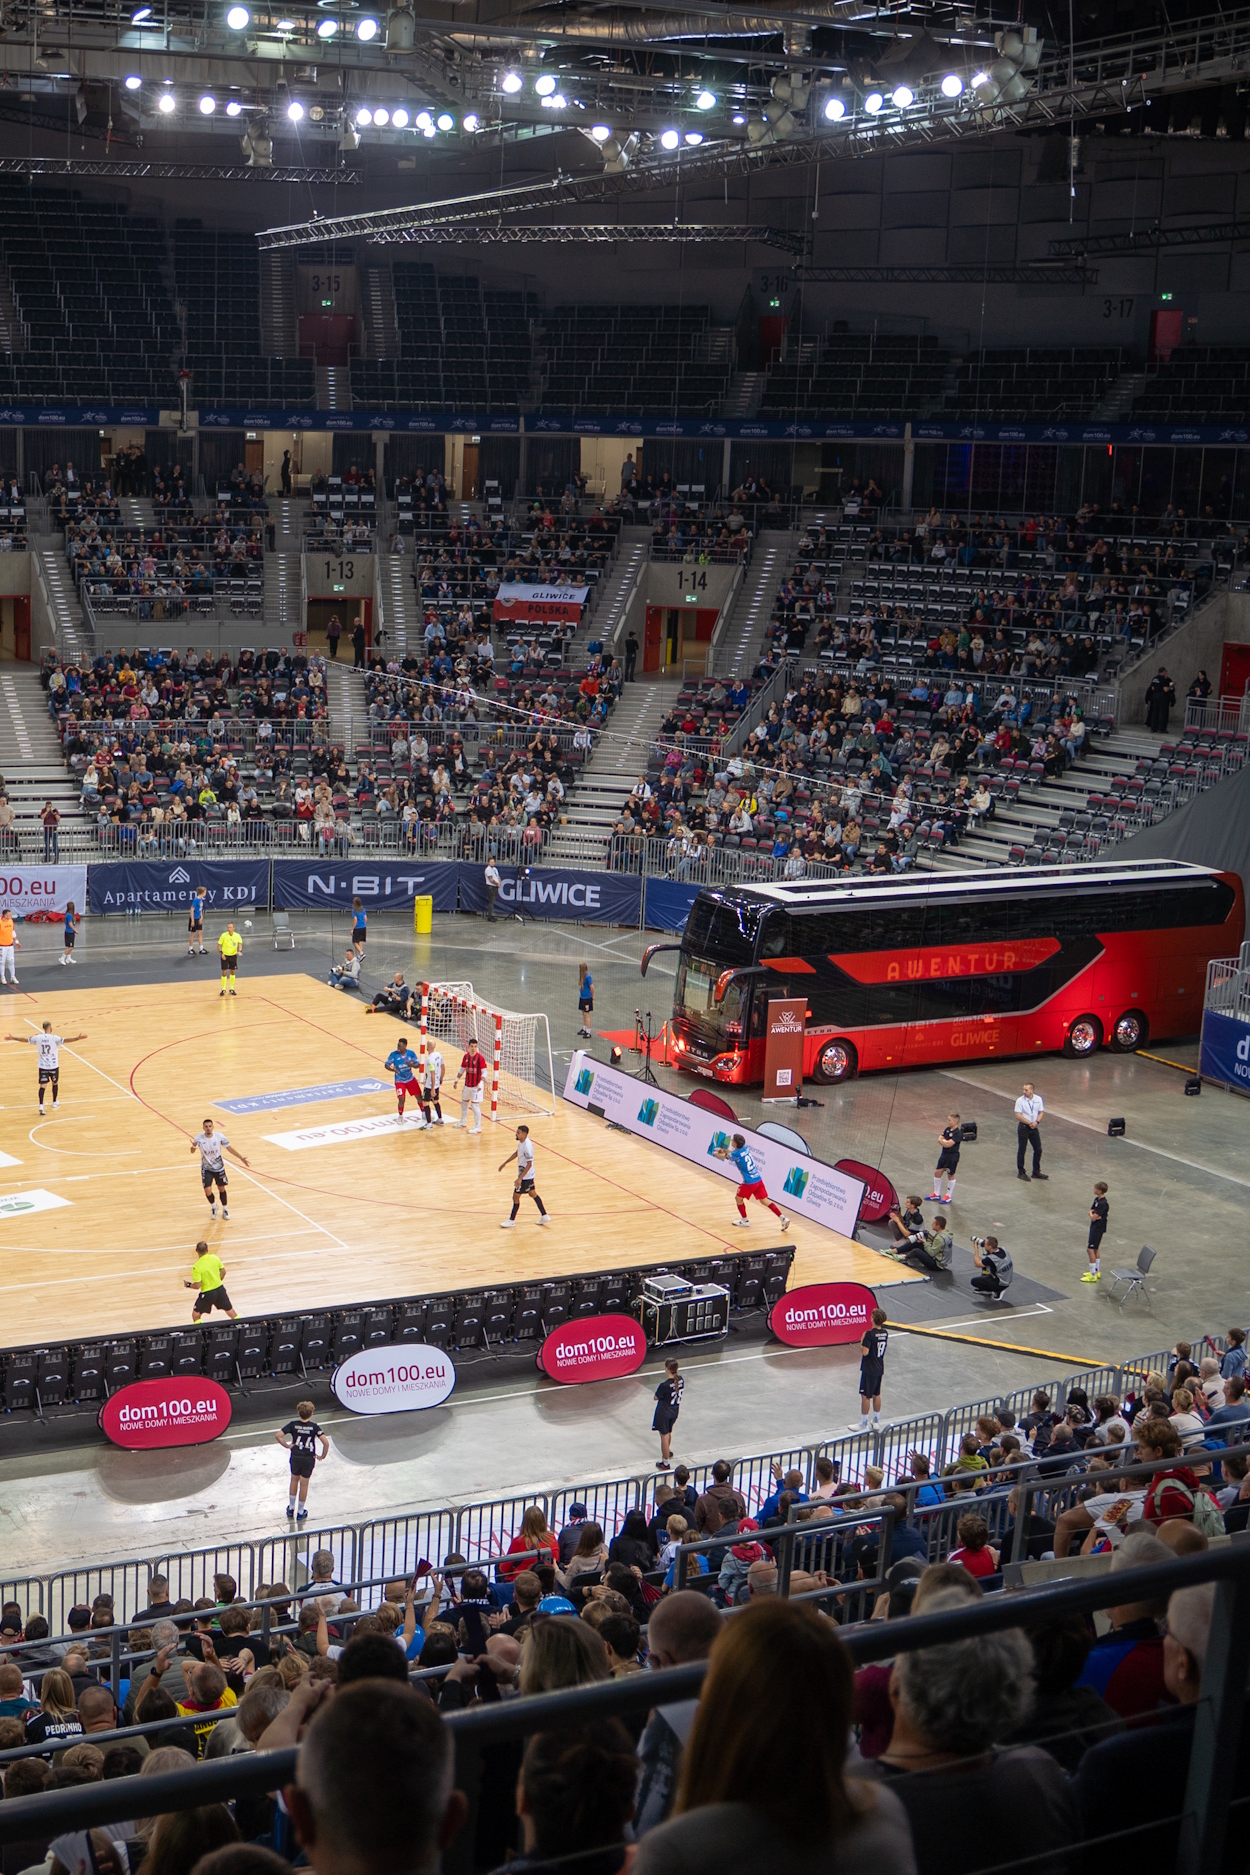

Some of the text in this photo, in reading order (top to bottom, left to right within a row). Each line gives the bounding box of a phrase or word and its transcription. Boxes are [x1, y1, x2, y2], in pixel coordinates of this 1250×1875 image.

[312, 275, 340, 292] 3-15
[324, 561, 353, 579] 1-13
[677, 570, 707, 590] 1-14
[532, 592, 576, 600] GLIWICE
[528, 604, 569, 615] POLSKA
[103, 885, 257, 906] Apartameny KDJ
[497, 878, 601, 907] GLIWICE
[0, 897, 56, 908] MIESZKANIA
[887, 952, 1015, 980] AWENTUR
[770, 1026, 802, 1034] AWENTUR
[950, 1029, 1000, 1047] GLIWICE
[41, 1044, 51, 1055] 17
[229, 1101, 259, 1110] KDJ
[295, 1114, 421, 1143] dom100.eu
[809, 1181, 847, 1204] Zagospodarowania
[811, 1174, 846, 1195] Przedsiębiorstwo
[806, 1196, 821, 1208] Gliwice
[808, 1189, 827, 1203] Odpadów
[785, 1303, 866, 1323] dom100.eu
[786, 1322, 807, 1331] NOWE
[807, 1320, 827, 1329] DOMY
[831, 1316, 867, 1326] MIESZKANIA
[555, 1335, 635, 1359] dom100.eu
[556, 1357, 577, 1368] NOWE
[578, 1354, 597, 1364] DOMY
[601, 1348, 636, 1360] MIESZKANIA
[345, 1365, 445, 1388] dom100.eu
[346, 1388, 371, 1398] NOWE
[372, 1385, 396, 1395] DOMY
[401, 1379, 447, 1392] MIESZKANIA
[119, 1399, 216, 1422] dom100.eu
[120, 1421, 143, 1431] NOWE
[145, 1418, 168, 1428] DOMY
[173, 1413, 217, 1425] MIESZKANIA
[294, 1435, 314, 1453] 44
[44, 1722, 82, 1736] PEDRINHO
